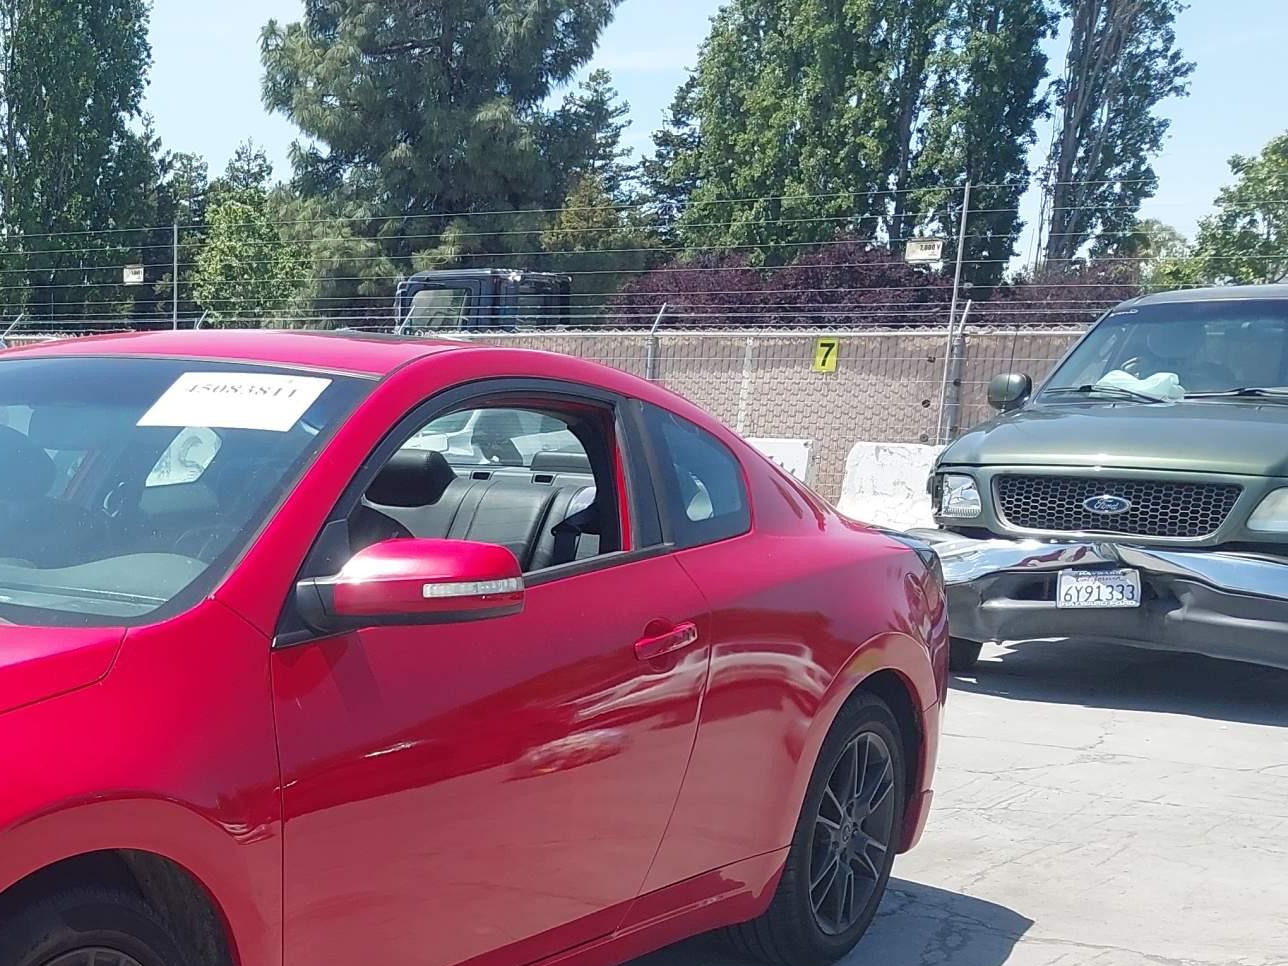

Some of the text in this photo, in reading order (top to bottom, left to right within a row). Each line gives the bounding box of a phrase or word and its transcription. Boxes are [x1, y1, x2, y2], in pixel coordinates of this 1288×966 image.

[819, 342, 836, 367] 7
[1093, 499, 1120, 510] Ford
[1063, 584, 1135, 602] 6Y91333
